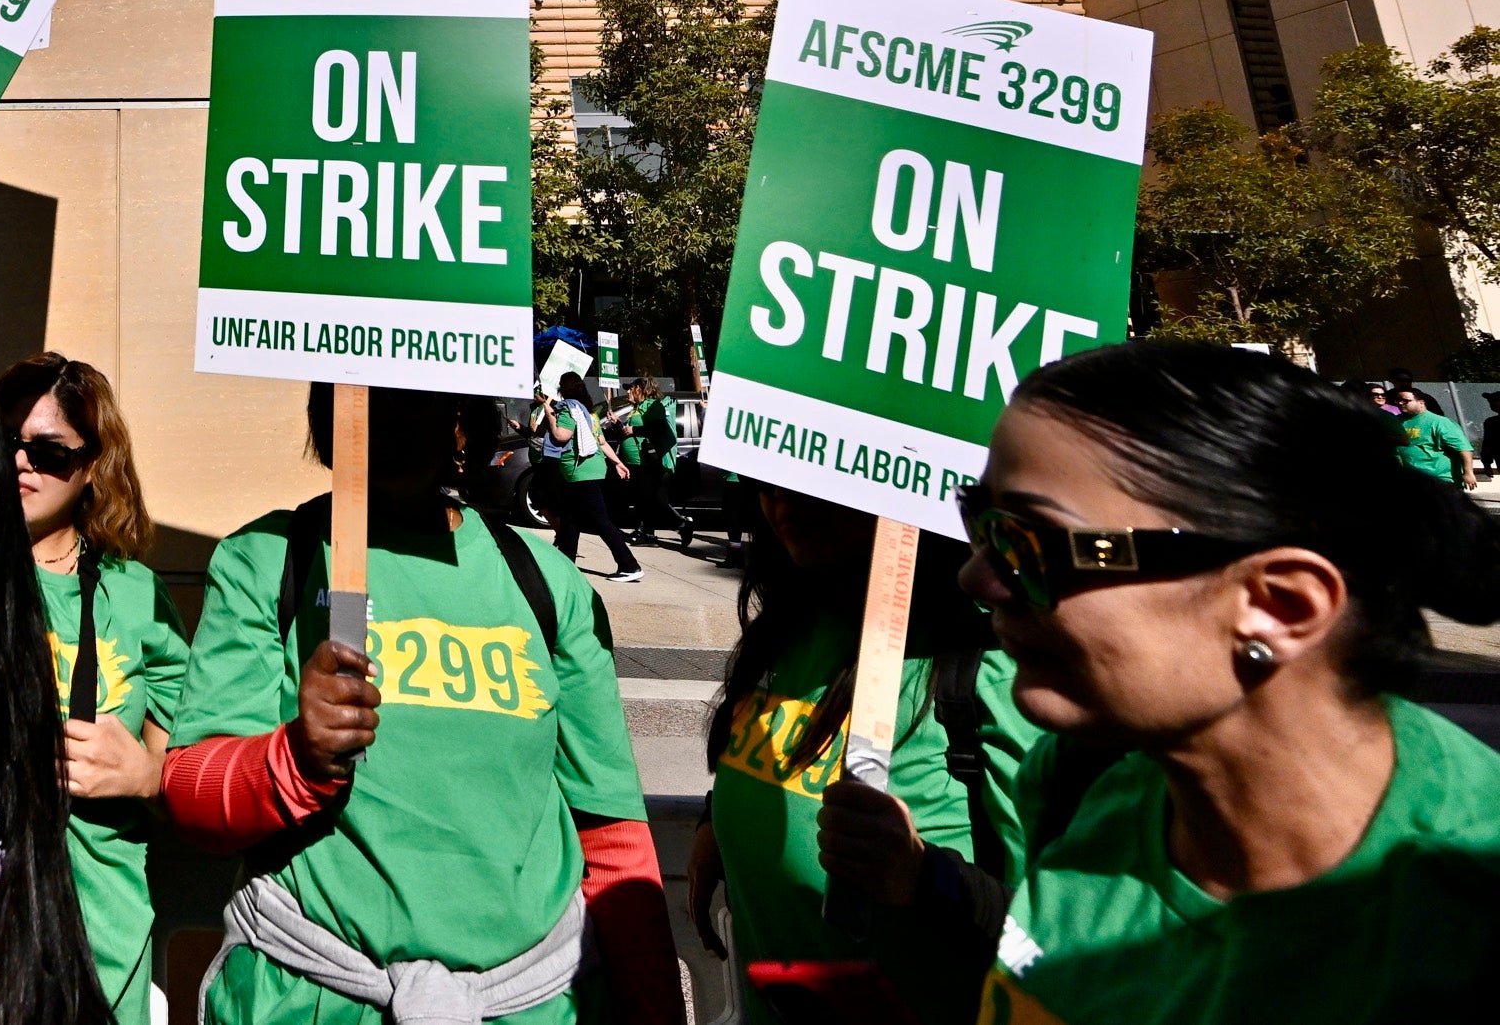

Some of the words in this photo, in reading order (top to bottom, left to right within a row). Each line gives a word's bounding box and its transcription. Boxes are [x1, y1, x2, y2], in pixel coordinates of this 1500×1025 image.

[312, 49, 417, 144] ON
[799, 18, 985, 101] AFSCME
[997, 61, 1122, 133] 3299
[222, 157, 508, 265] STRIKE
[871, 148, 1004, 273] ON
[212, 317, 295, 351] UNFAIR
[303, 322, 383, 358] LABOR
[391, 328, 515, 367] PRACTICE
[724, 406, 827, 465] UNFAIR
[835, 437, 930, 496] LABOR
[893, 551, 912, 610] HOME
[887, 613, 905, 651] THE
